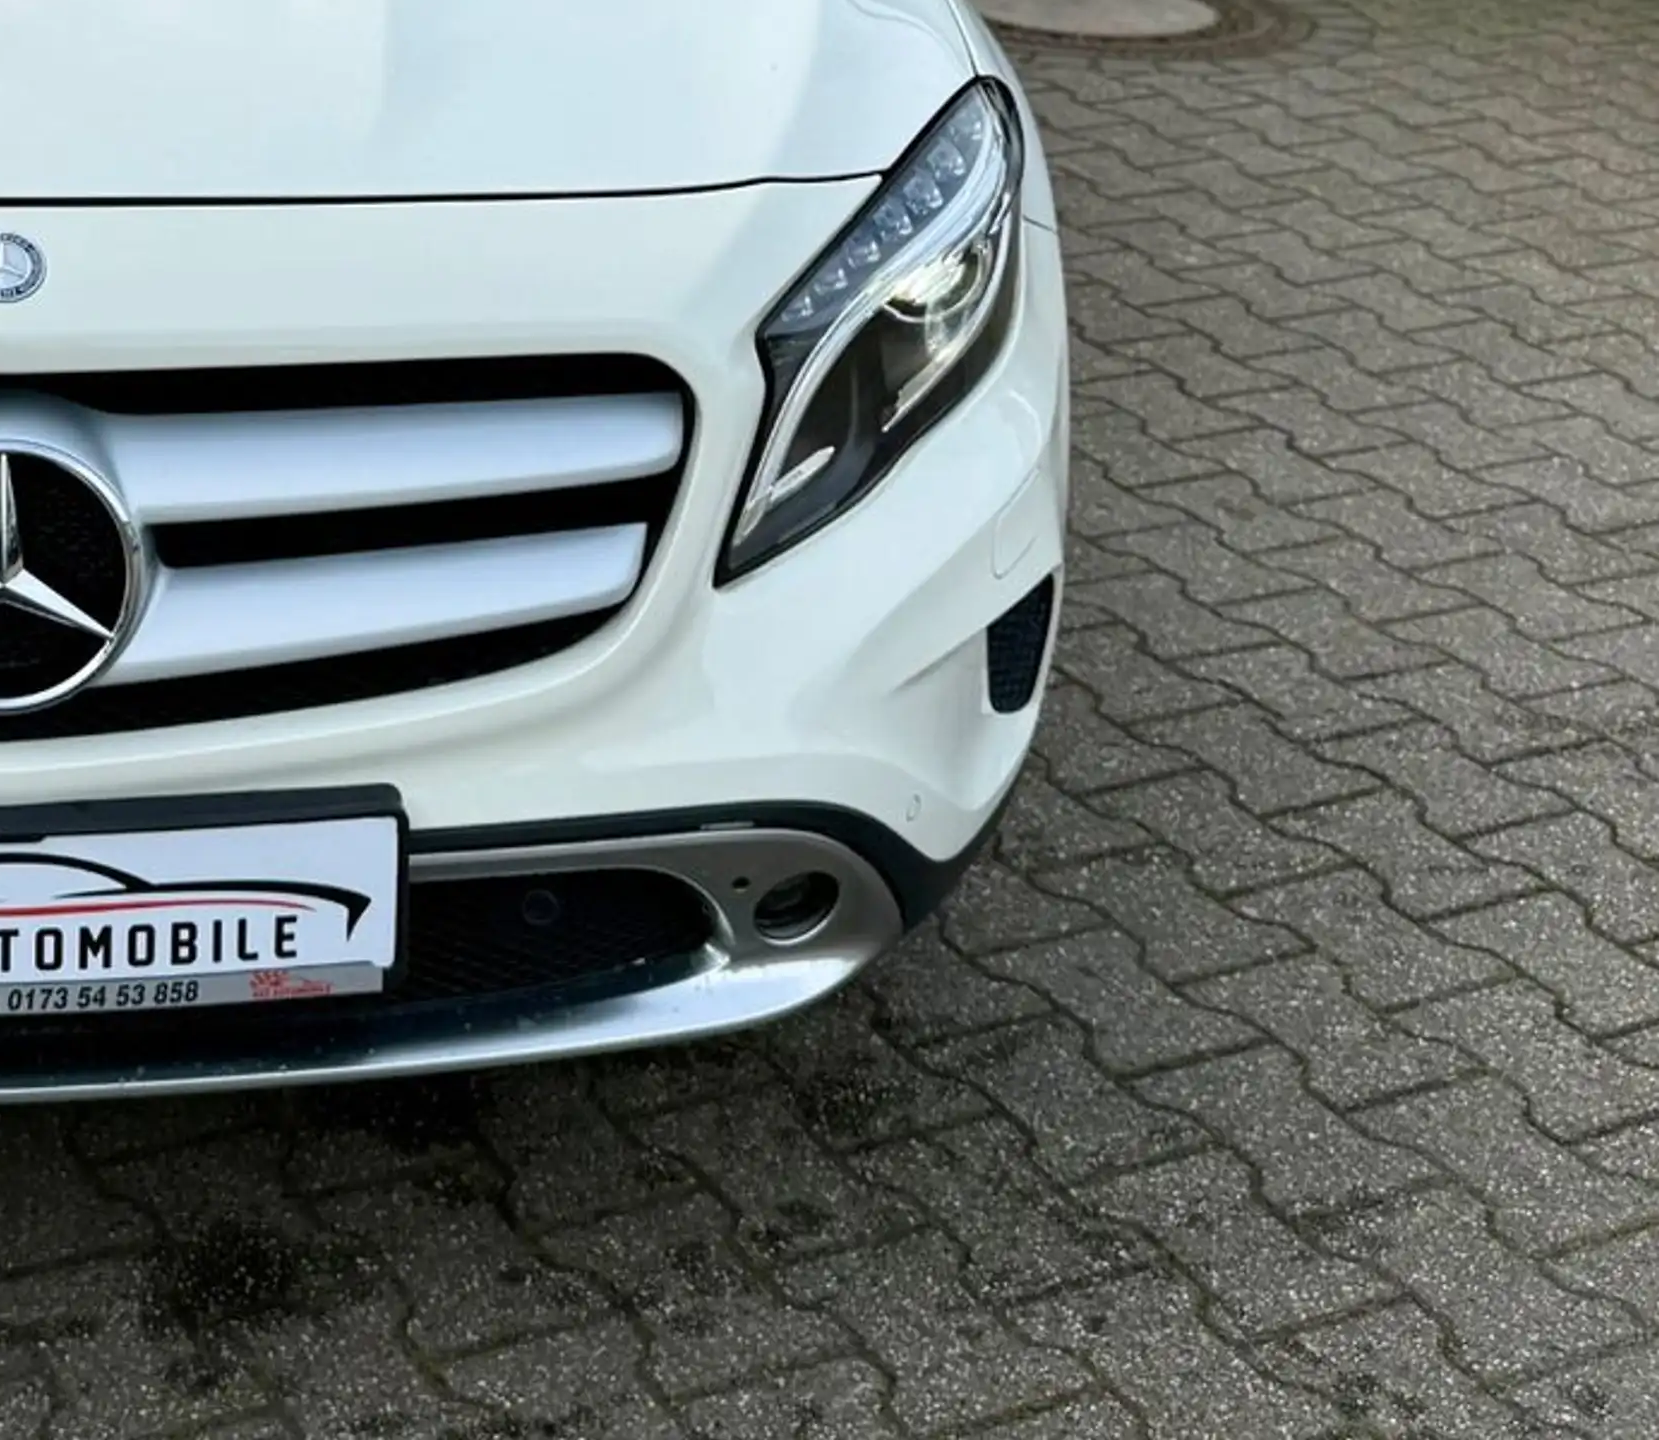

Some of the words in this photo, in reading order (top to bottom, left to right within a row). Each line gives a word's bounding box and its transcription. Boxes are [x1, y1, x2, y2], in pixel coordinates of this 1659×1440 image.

[7, 987, 69, 1011] 0173
[76, 986, 106, 1009] 54
[115, 984, 146, 1007] 53
[153, 980, 199, 1004] 858
